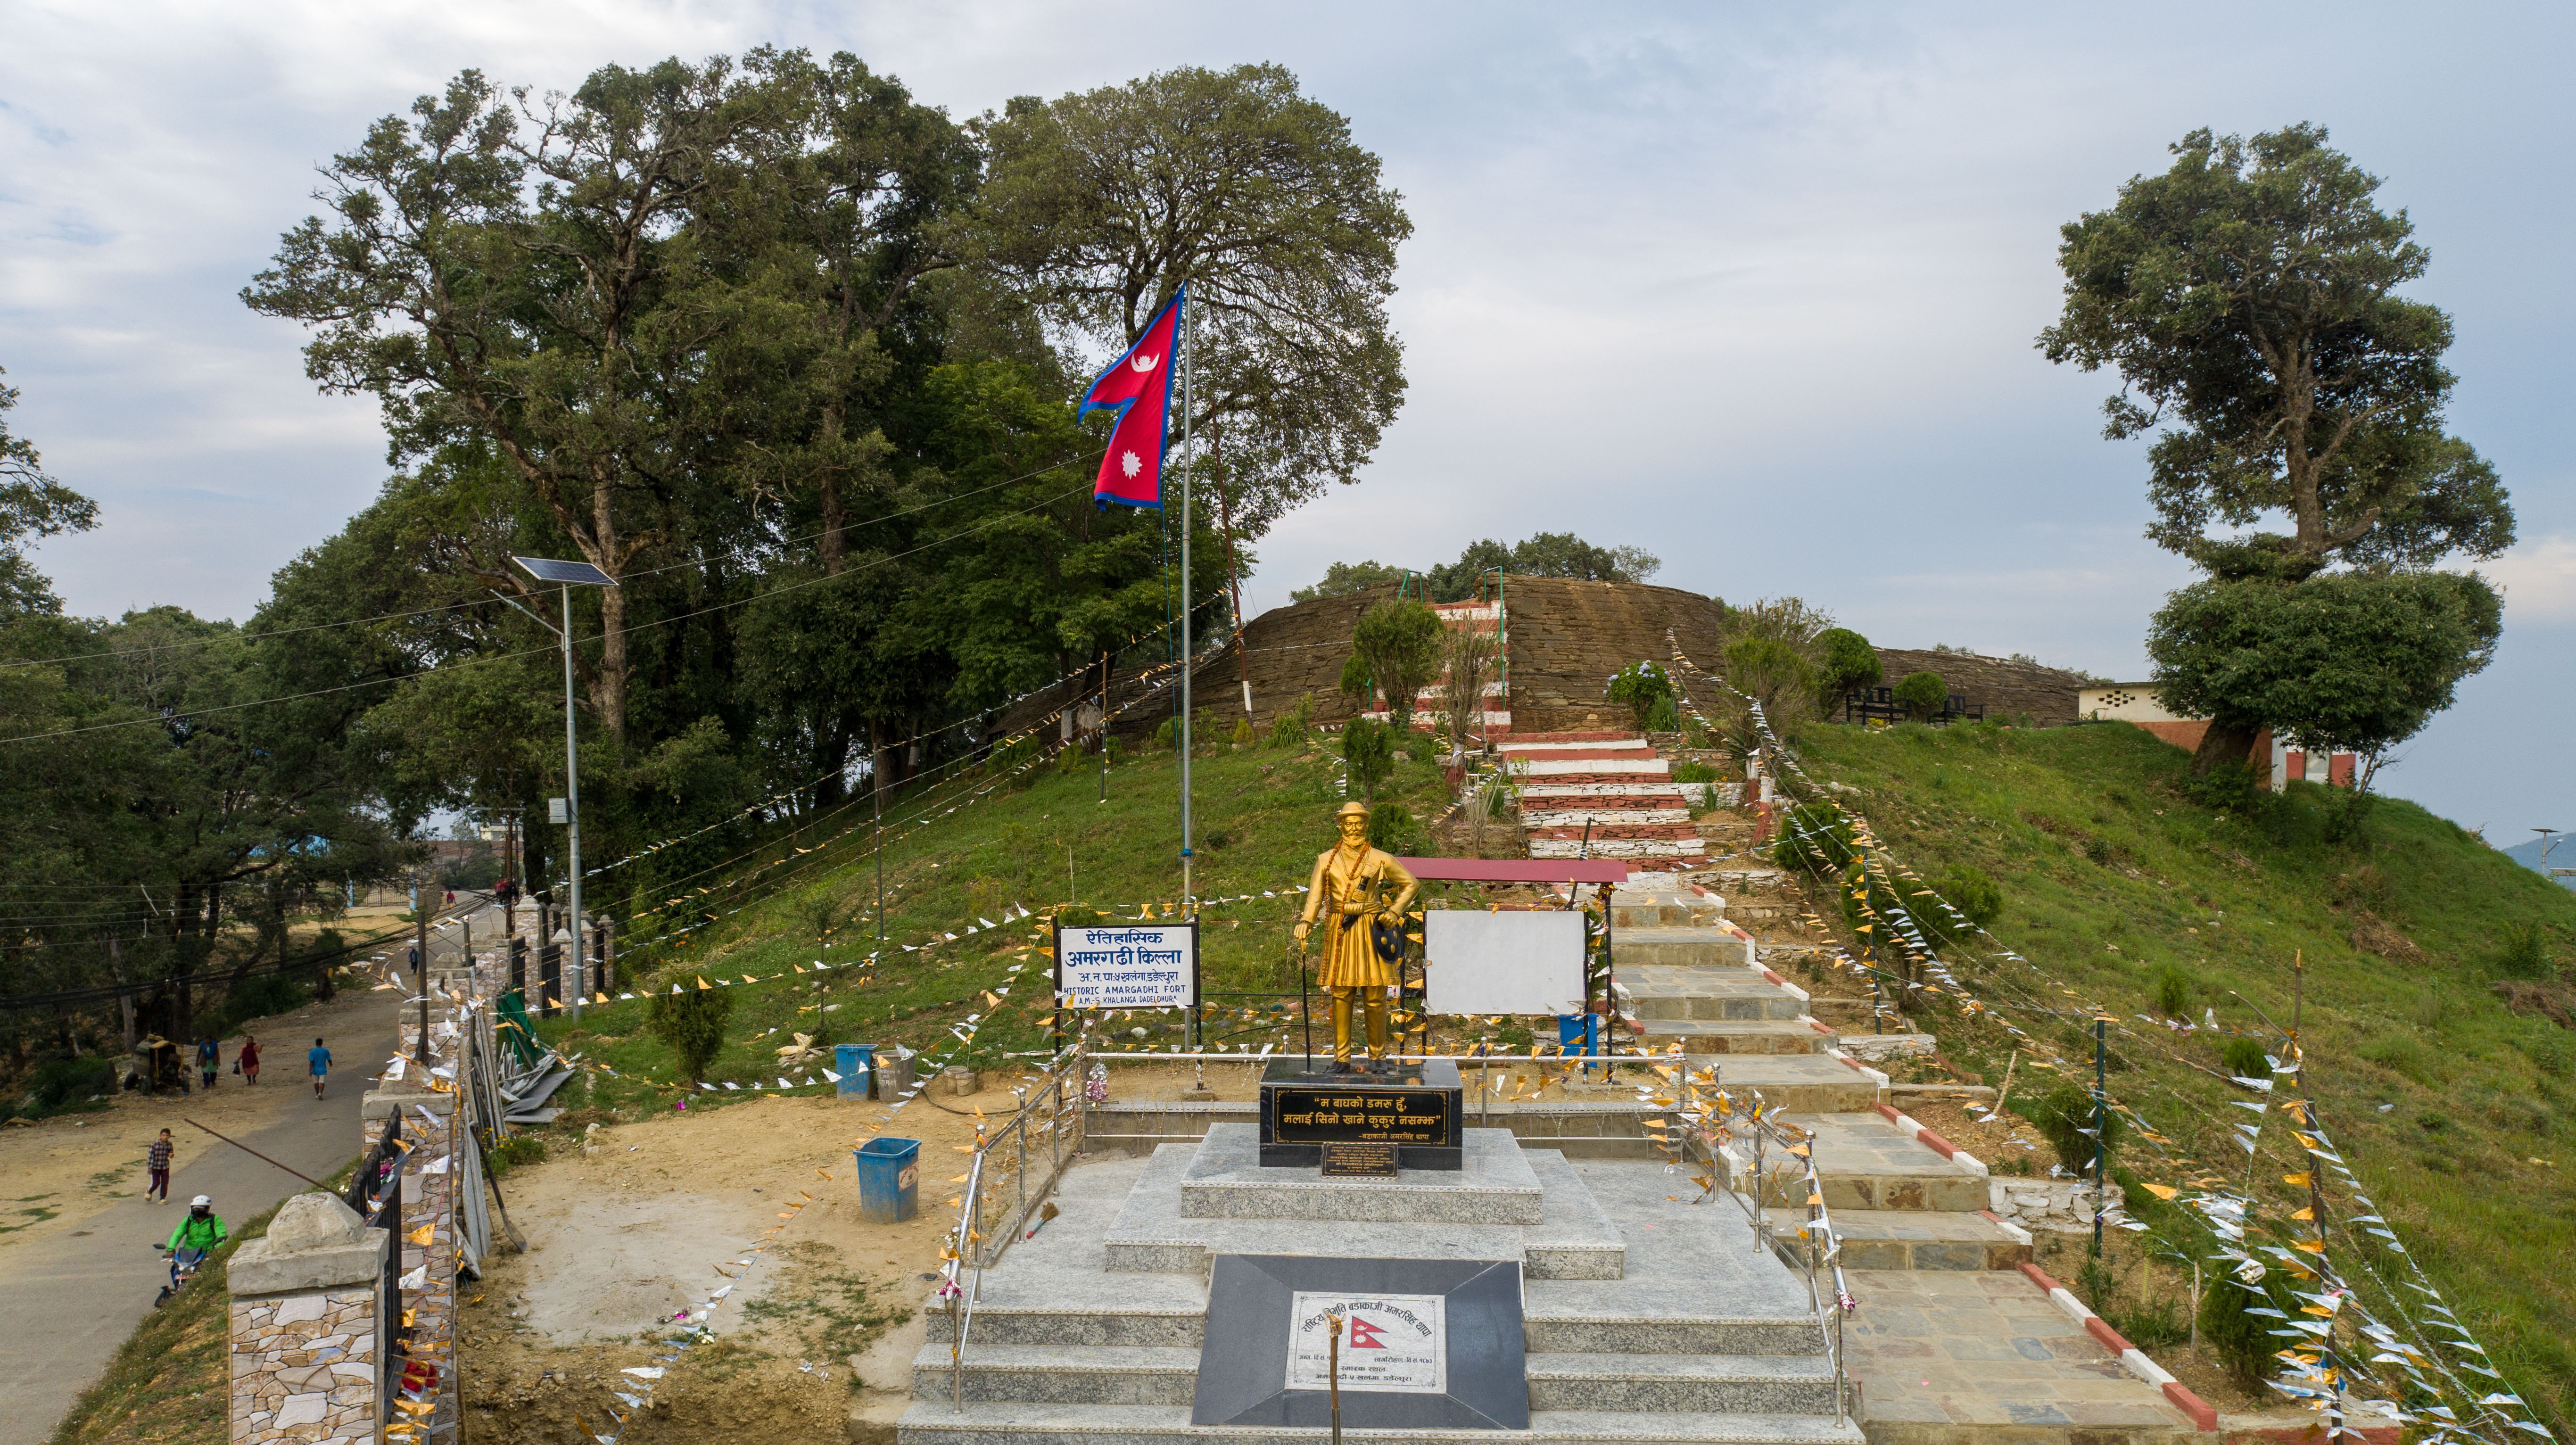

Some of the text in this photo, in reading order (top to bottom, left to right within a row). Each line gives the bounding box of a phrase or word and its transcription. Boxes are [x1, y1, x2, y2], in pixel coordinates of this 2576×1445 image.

[1086, 929, 1164, 945] ऐतिहासिक
[1065, 946, 1182, 966] अमरगढी किल्ला
[1064, 987, 1099, 995] HISTORIC
[1333, 1096, 1364, 1107] बाघको
[1283, 1112, 1313, 1125] मलाई
[1315, 1112, 1339, 1124] सिनो
[1343, 1112, 1365, 1124] खाने
[1368, 1115, 1395, 1128] कुकुर
[1390, 1132, 1414, 1140] अमरसिंह
[1348, 1301, 1382, 1311] बडाकाजी
[1384, 1305, 1418, 1325] अमरसिंह
[1416, 1322, 1432, 1337] थापा
